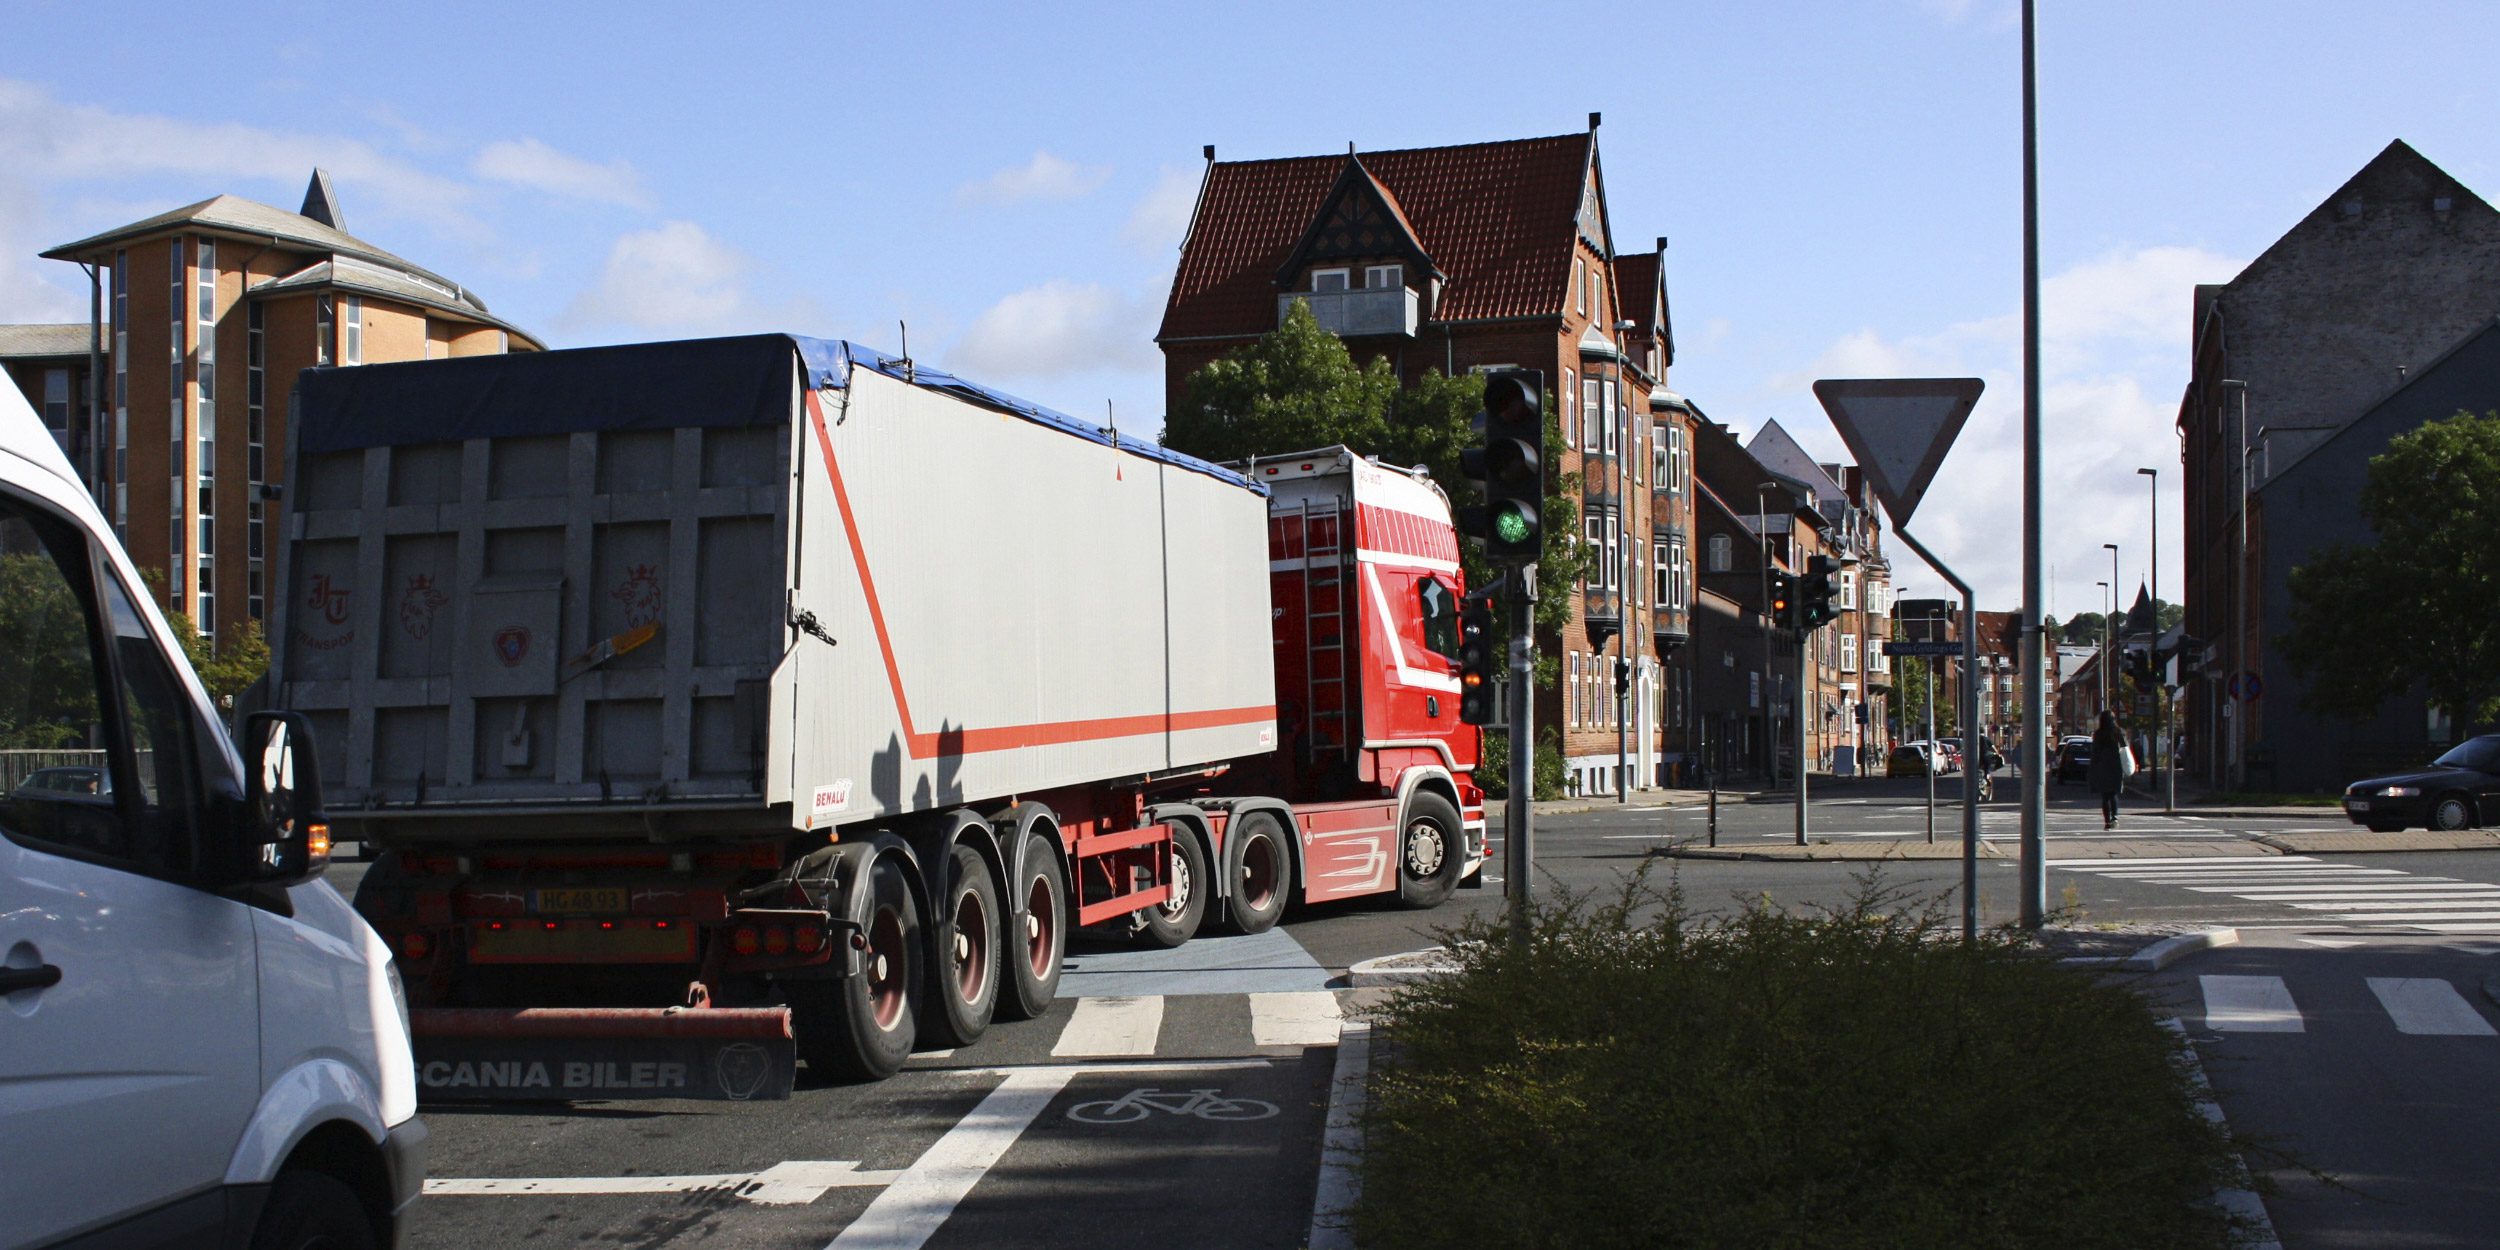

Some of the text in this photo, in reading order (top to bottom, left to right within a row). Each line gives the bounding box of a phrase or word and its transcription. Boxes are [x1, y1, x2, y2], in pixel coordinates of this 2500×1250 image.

[295, 627, 355, 651] TRANSPOR
[815, 790, 846, 807] BENALU
[543, 891, 569, 910] HG
[562, 1061, 687, 1088] BILER
